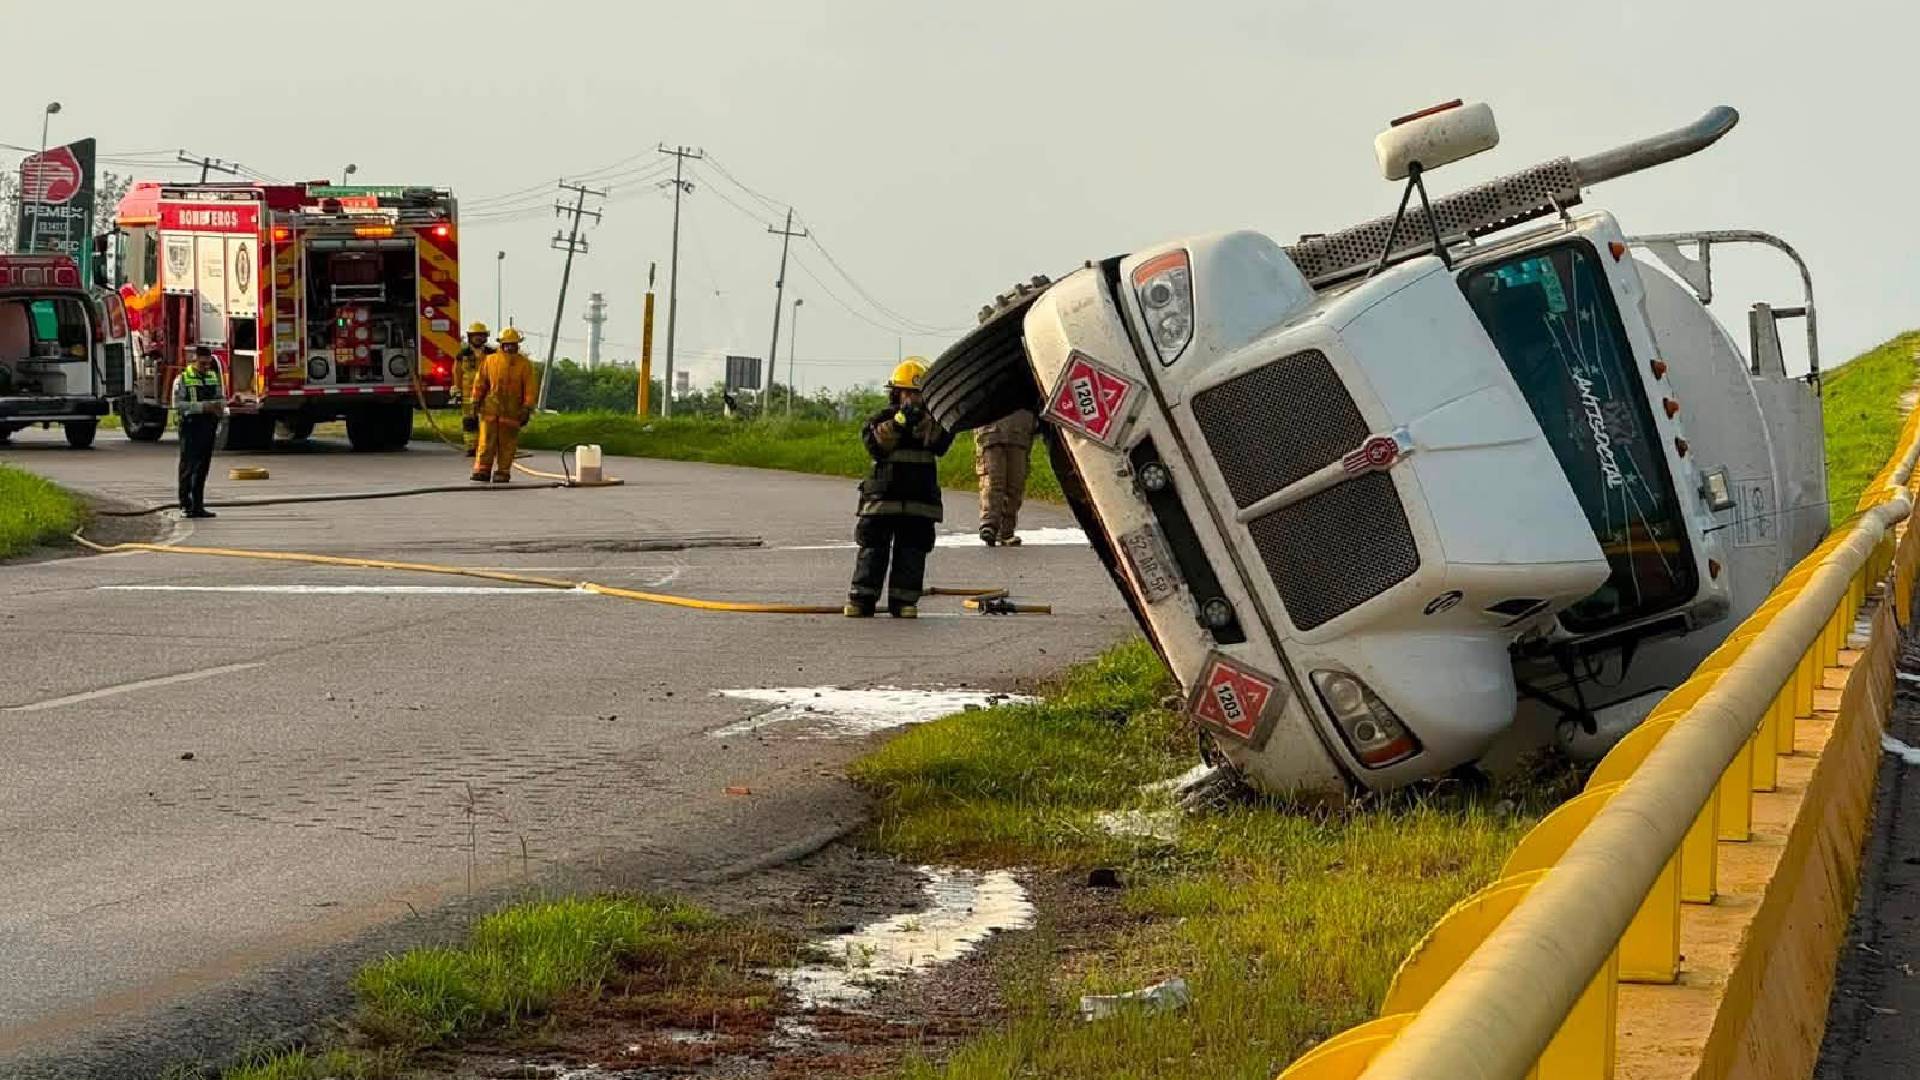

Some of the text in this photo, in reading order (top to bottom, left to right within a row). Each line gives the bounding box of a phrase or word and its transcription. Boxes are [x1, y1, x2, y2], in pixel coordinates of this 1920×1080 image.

[24, 205, 83, 219] PEMEX
[178, 209, 237, 228] BOMBEROS
[1075, 380, 1096, 416] 1203
[1218, 685, 1240, 720] 1203
